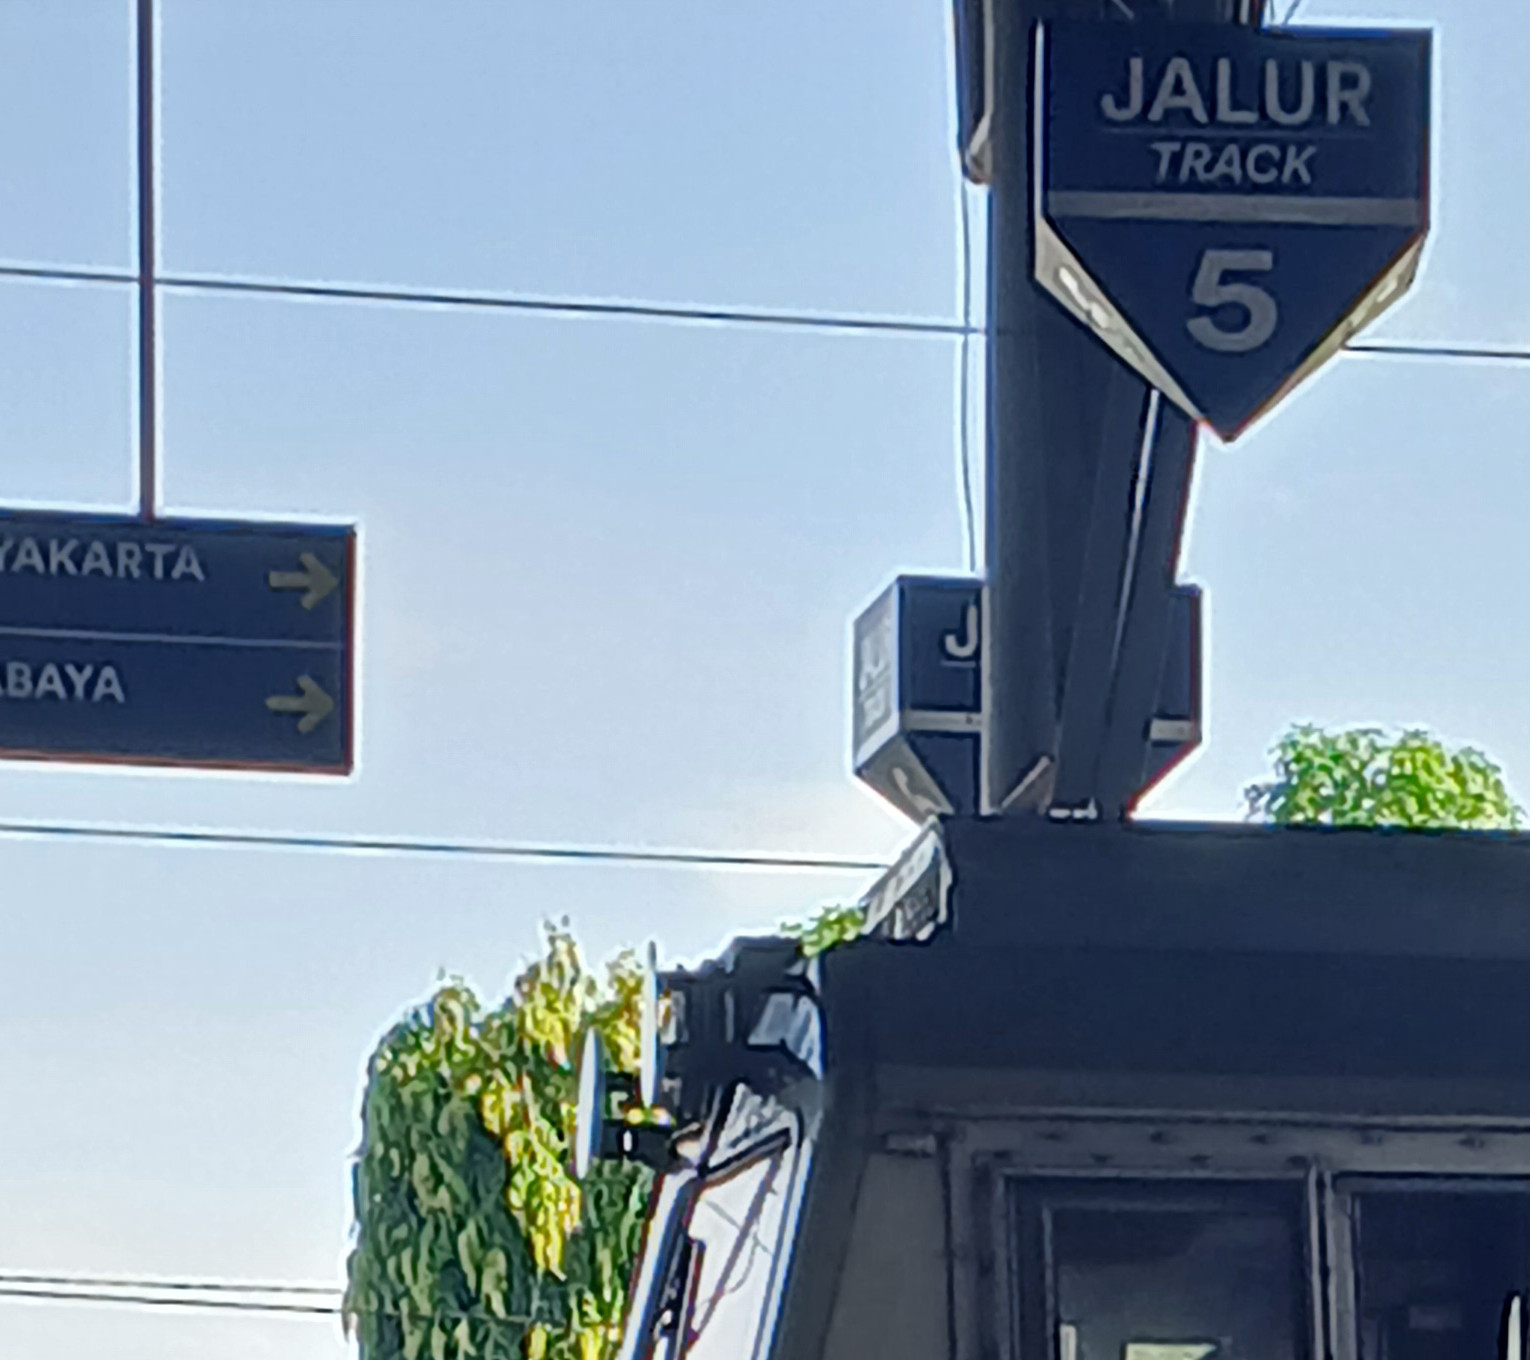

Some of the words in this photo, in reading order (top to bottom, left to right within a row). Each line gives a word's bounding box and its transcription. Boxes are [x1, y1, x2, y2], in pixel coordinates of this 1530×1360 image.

[1101, 57, 1372, 126] JALUR
[1150, 141, 1317, 185] TRACK
[1186, 249, 1278, 352] 5
[0, 661, 125, 703] BAYA
